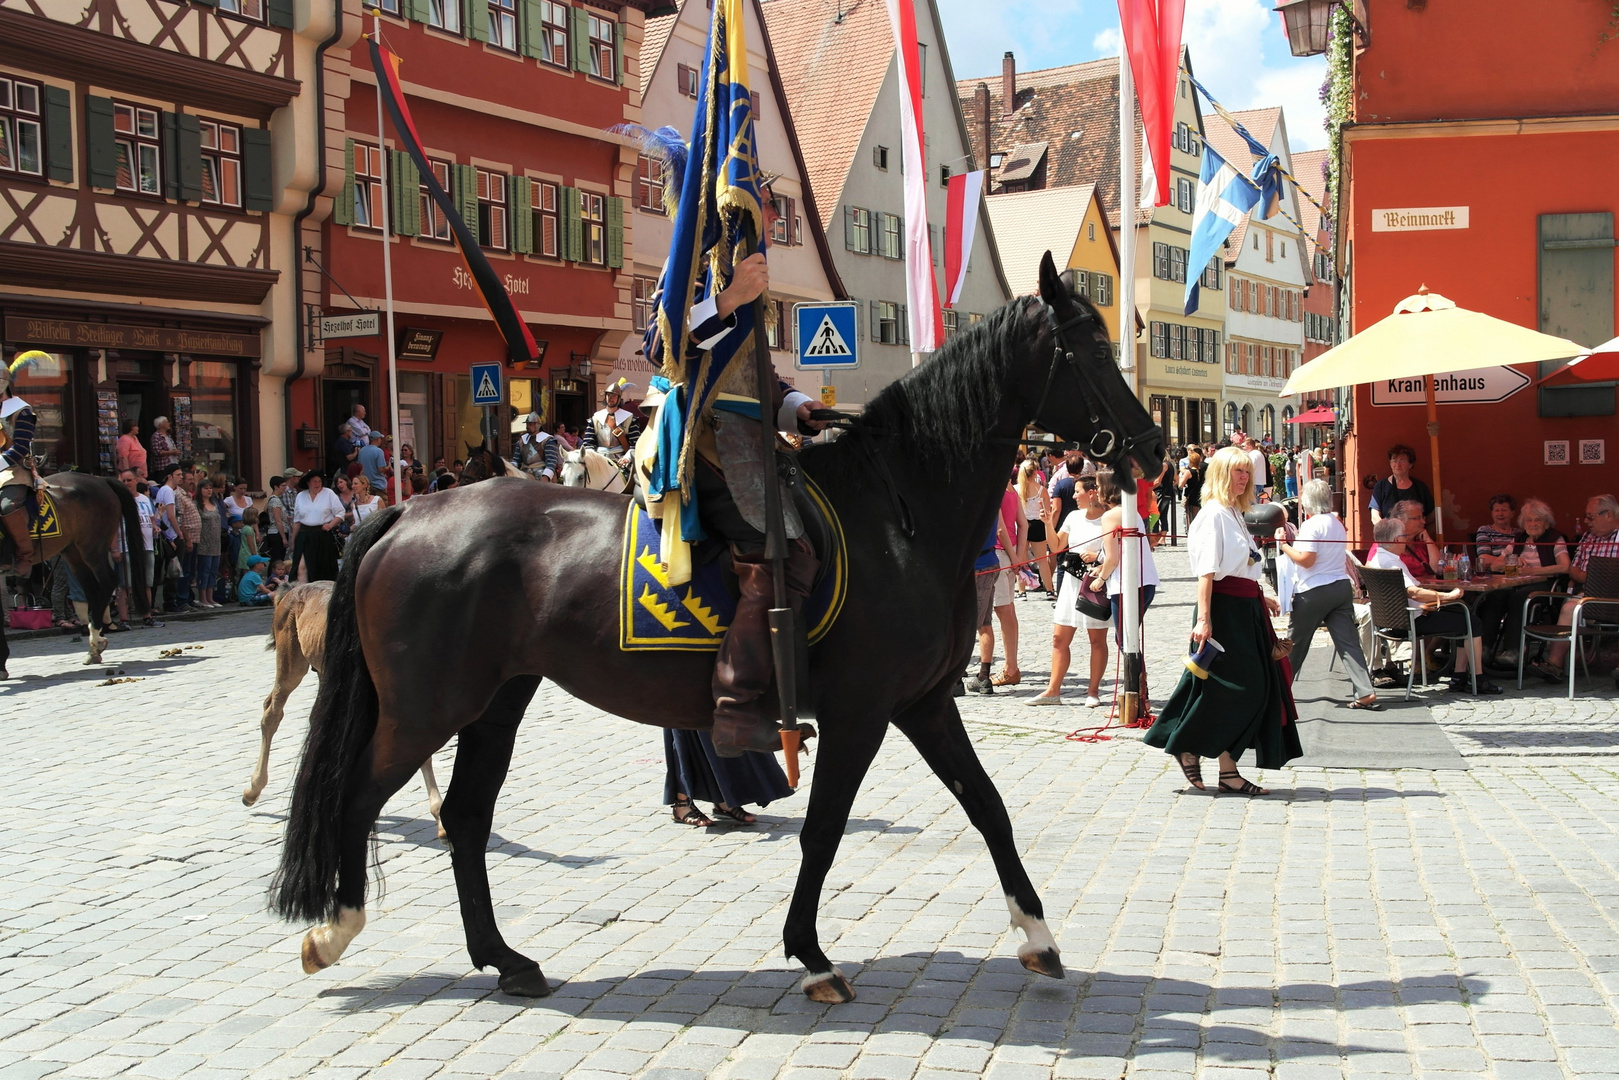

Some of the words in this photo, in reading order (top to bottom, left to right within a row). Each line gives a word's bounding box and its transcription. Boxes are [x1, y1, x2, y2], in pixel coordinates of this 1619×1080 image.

[1383, 210, 1456, 227] Weinmarkt
[503, 274, 530, 296] Hotel
[27, 320, 71, 341] Wilhelm
[323, 320, 353, 334] Hezelhof
[356, 318, 375, 331] Hotel
